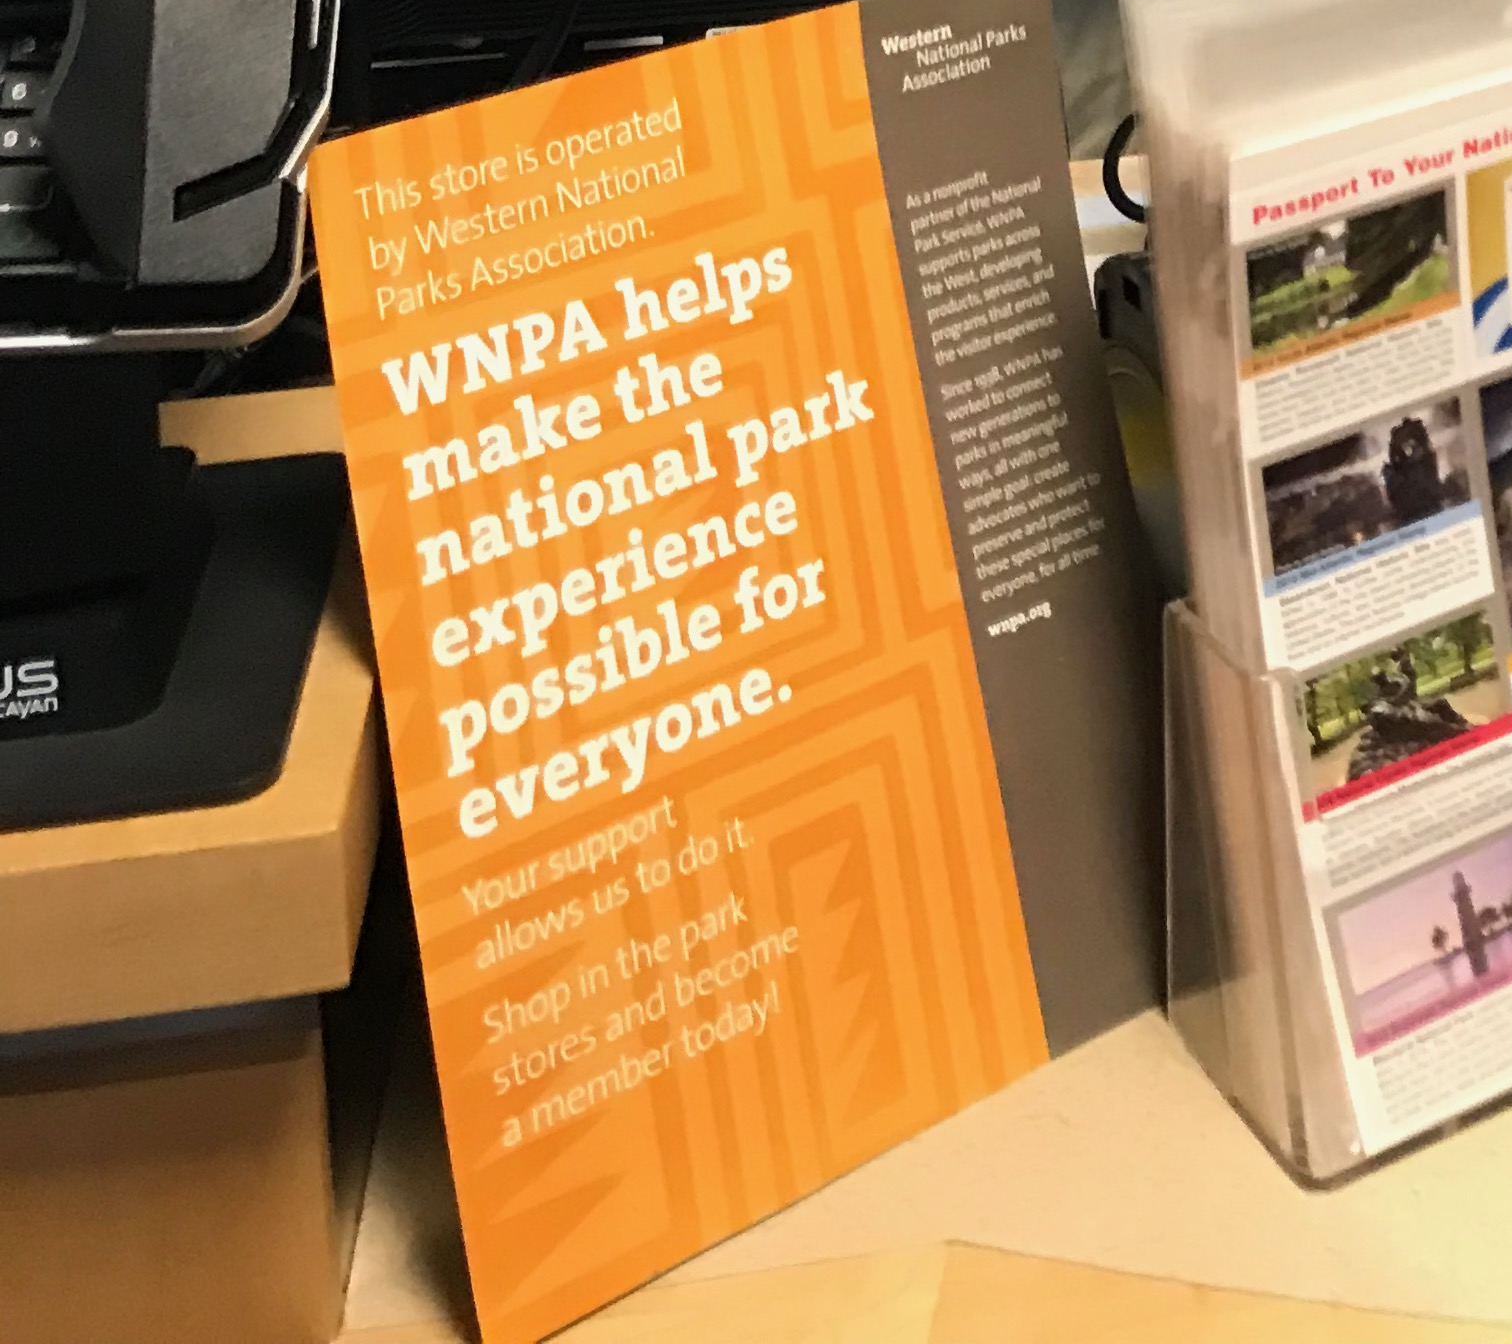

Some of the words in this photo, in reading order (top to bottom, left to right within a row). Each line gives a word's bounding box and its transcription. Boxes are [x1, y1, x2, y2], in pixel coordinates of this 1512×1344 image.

[881, 24, 952, 55] Western
[902, 55, 990, 92] Association
[916, 32, 982, 67] National
[985, 24, 1026, 47] Parks
[353, 178, 422, 221] This
[431, 154, 507, 201] store
[516, 144, 540, 175] is
[546, 96, 682, 171] operated
[368, 235, 408, 278] by
[413, 192, 549, 256] Western
[555, 145, 687, 213] National
[1252, 176, 1360, 226] Passport
[1369, 165, 1396, 189] To
[1402, 149, 1455, 180] Your
[376, 269, 463, 322] Parks
[471, 215, 656, 292] Association.
[382, 299, 608, 416] WNPA
[615, 246, 793, 342] helps
[402, 393, 602, 502] make
[613, 352, 724, 424] the
[416, 419, 718, 587] national
[727, 369, 875, 488] park
[431, 490, 799, 668] experience
[987, 601, 1051, 636] wnpa.org
[438, 597, 723, 780] possible
[733, 558, 827, 634] for
[458, 667, 793, 839] everyone.
[460, 859, 540, 917] Your
[548, 795, 678, 881] support
[476, 898, 585, 970] allows
[592, 877, 631, 916] us
[635, 858, 671, 894] to
[677, 834, 719, 877] do
[724, 816, 756, 855] it.
[482, 981, 571, 1045] Shop
[578, 963, 610, 999] in
[615, 933, 672, 981] the
[680, 891, 748, 960] park
[492, 1026, 598, 1097] stores
[605, 982, 667, 1044] and
[673, 926, 799, 1011] become
[501, 1116, 523, 1149] a
[530, 1041, 674, 1136] member
[680, 981, 782, 1059] today!
